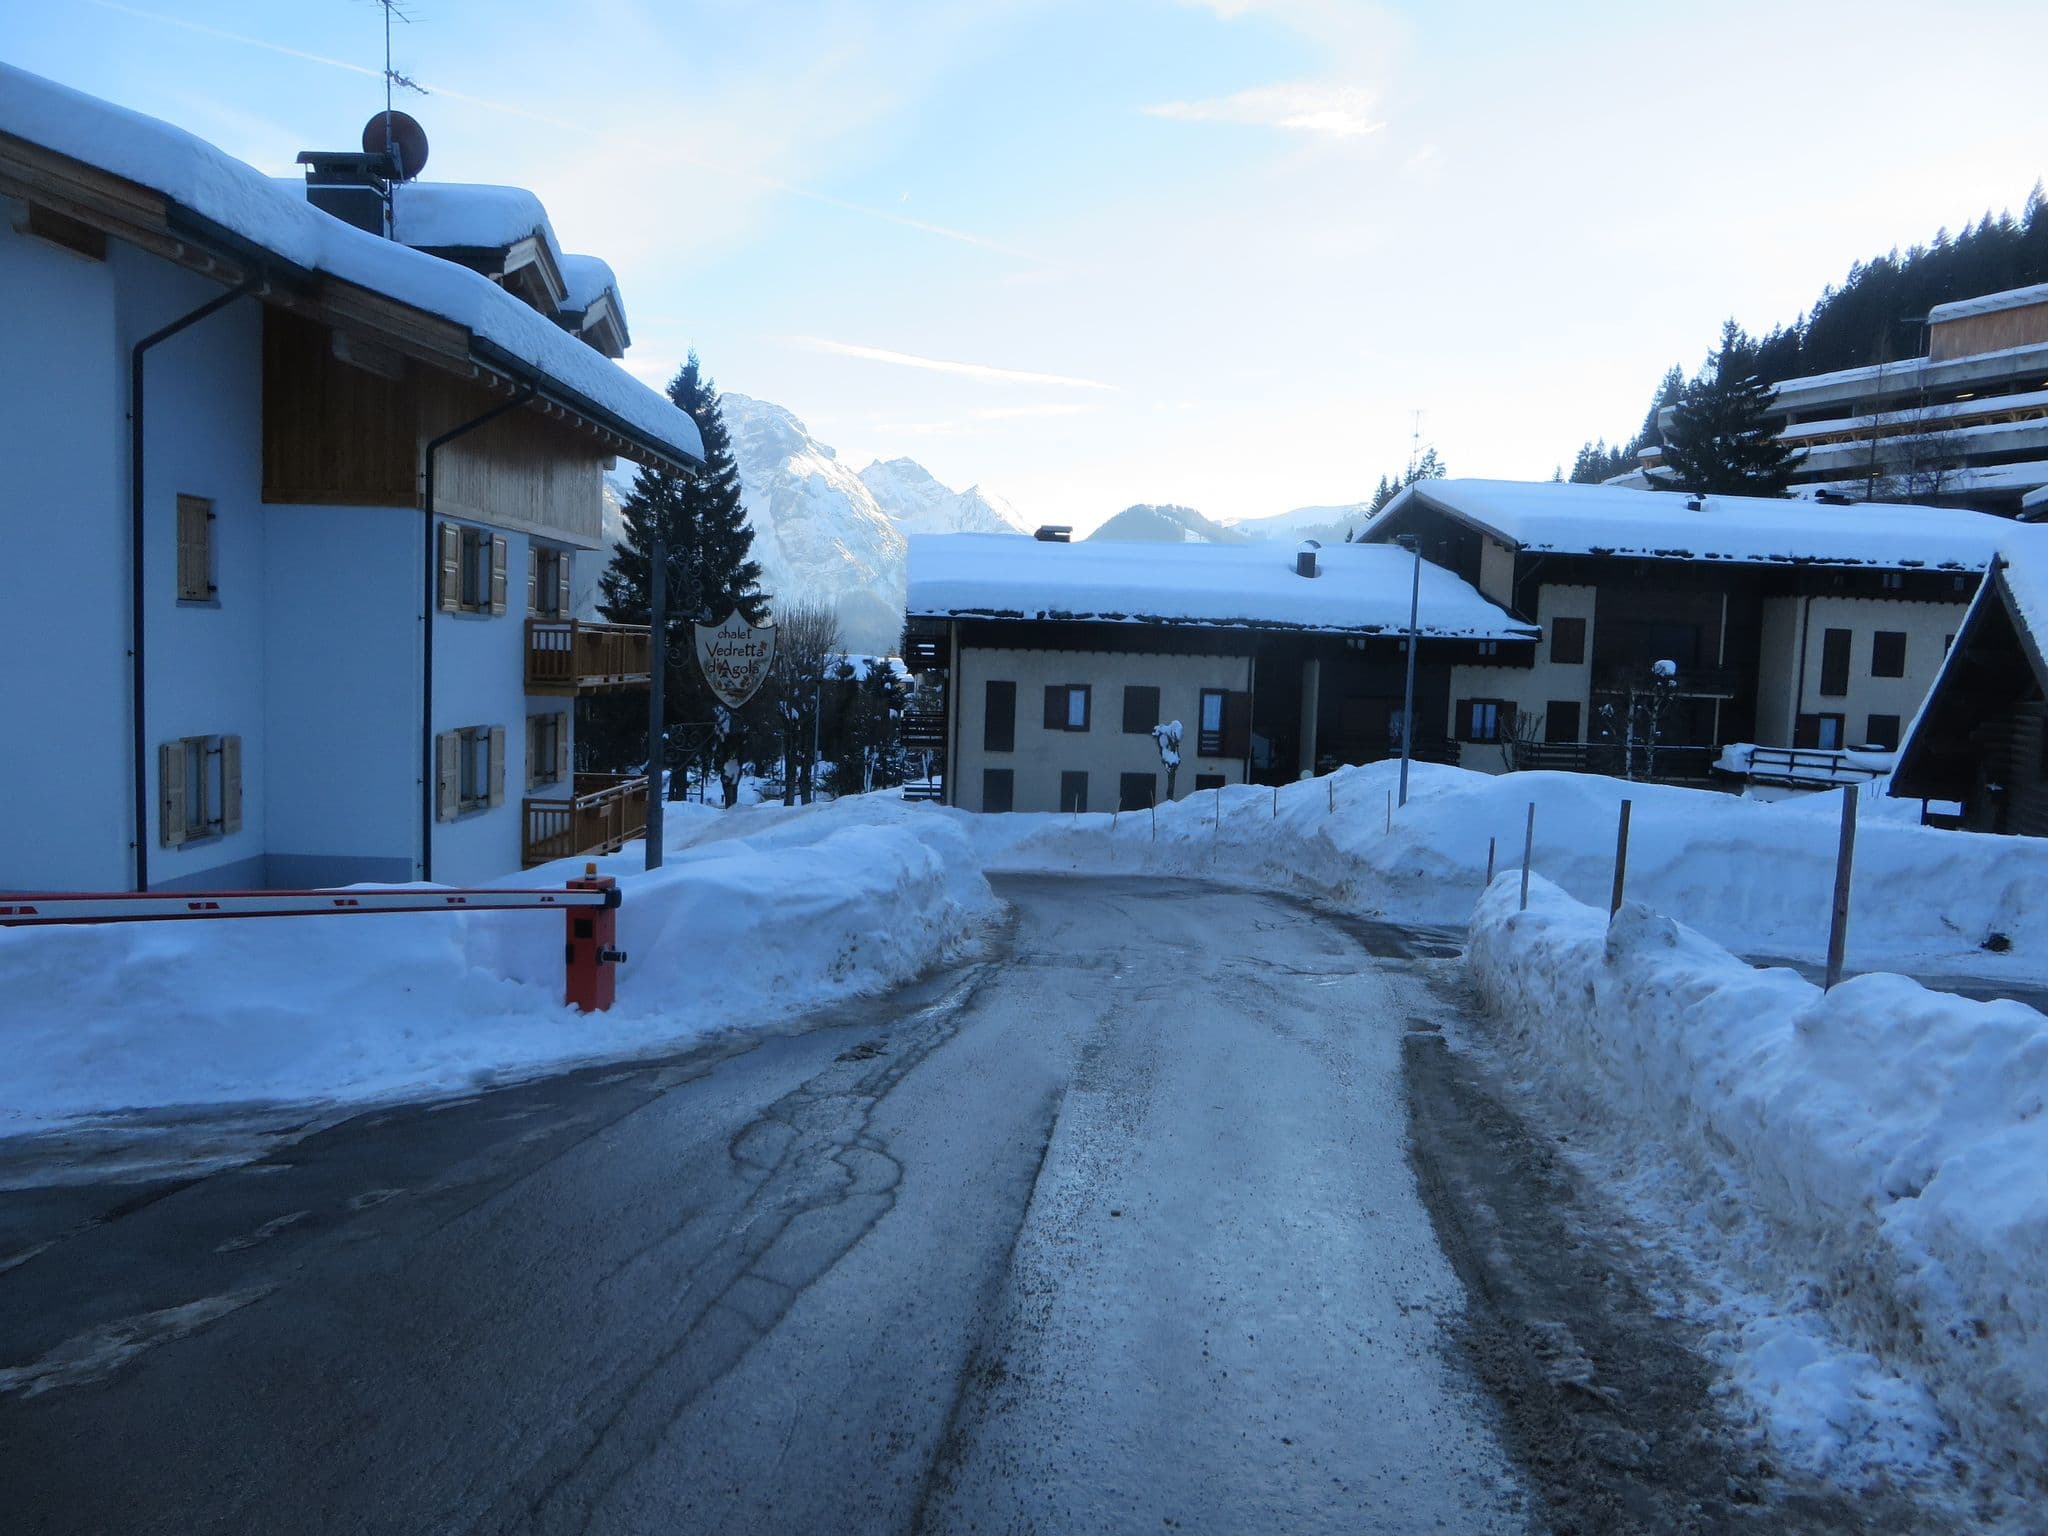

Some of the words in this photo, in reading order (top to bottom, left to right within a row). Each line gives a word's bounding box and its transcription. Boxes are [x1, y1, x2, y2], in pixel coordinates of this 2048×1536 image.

[717, 626, 752, 639] chalet
[705, 641, 764, 657] Vedretta
[708, 658, 760, 679] d'Agola
